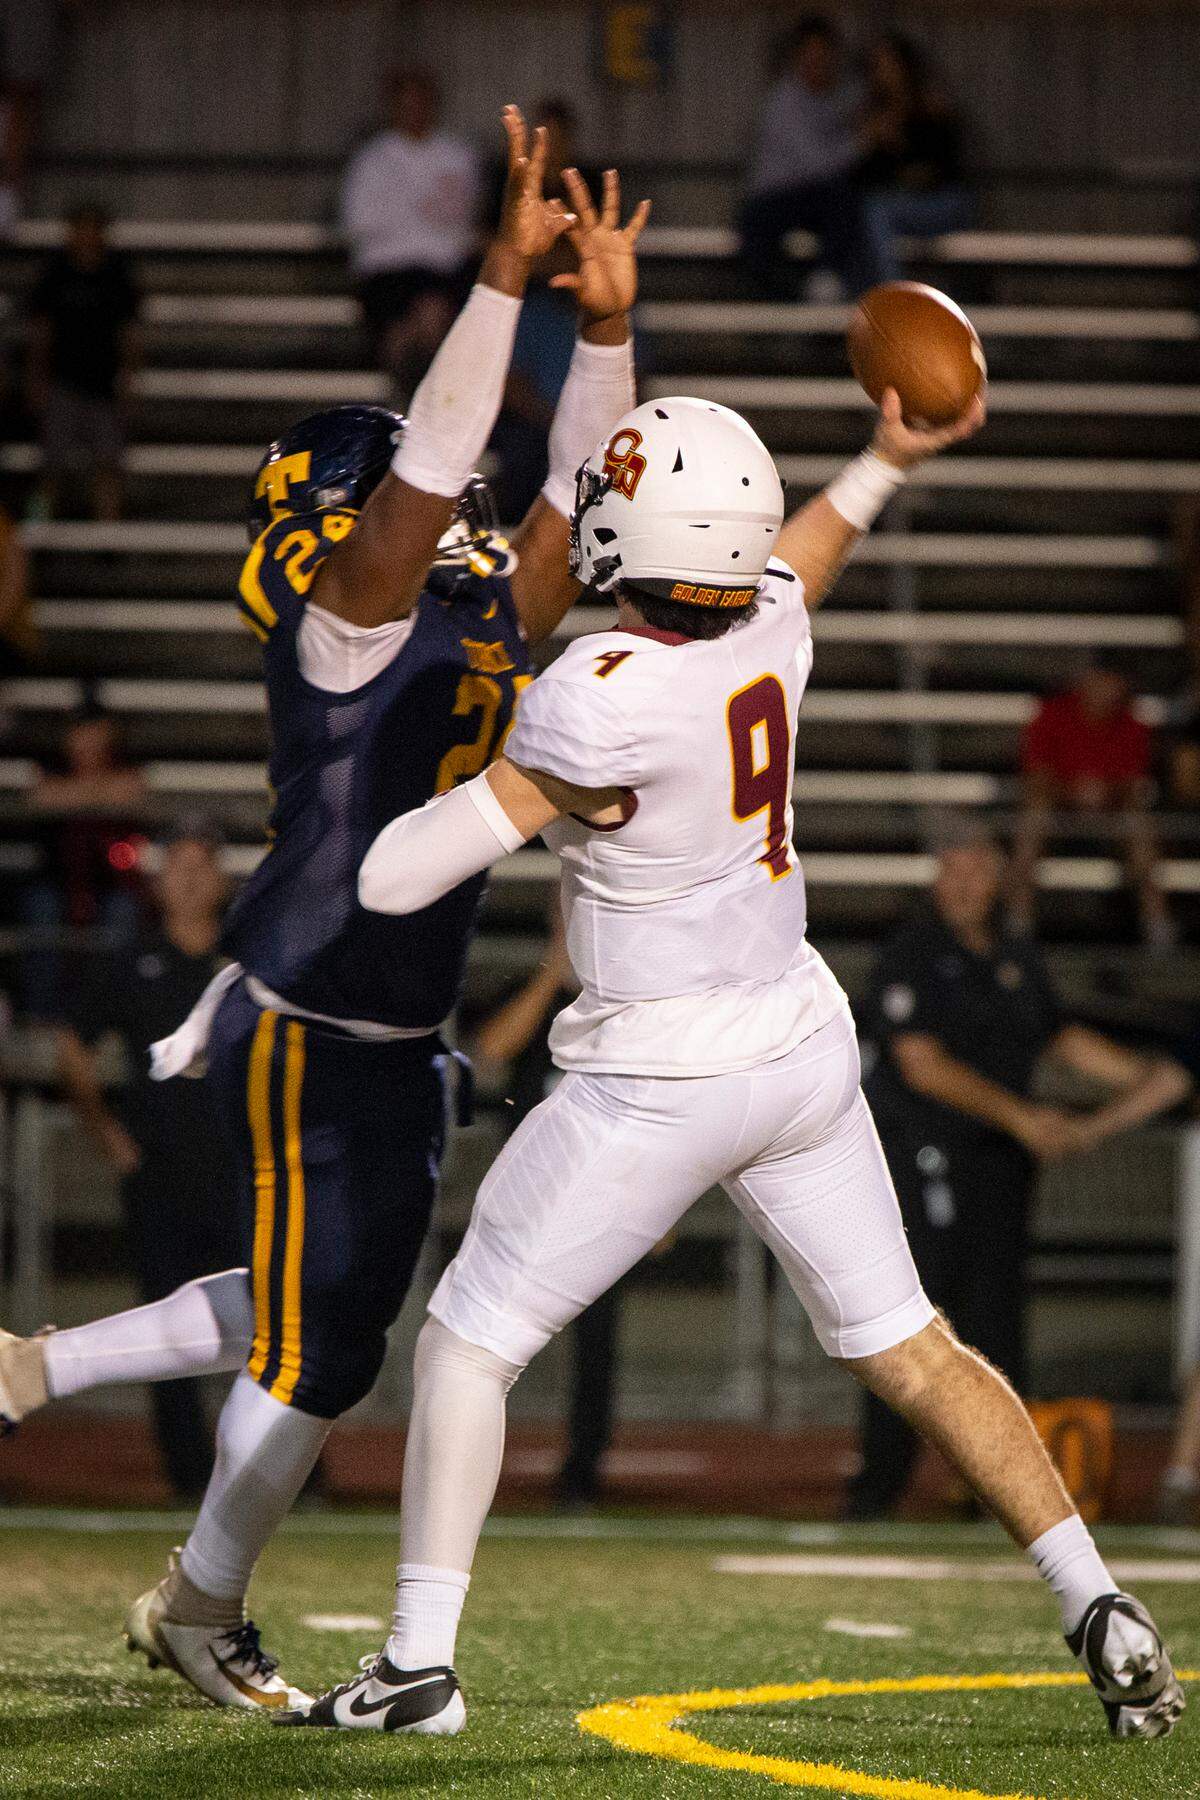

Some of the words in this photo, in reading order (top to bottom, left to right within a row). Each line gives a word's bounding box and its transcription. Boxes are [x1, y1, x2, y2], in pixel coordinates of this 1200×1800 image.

[254, 451, 313, 520] T
[671, 583, 722, 606] GOLDEN
[725, 671, 793, 884] 9
